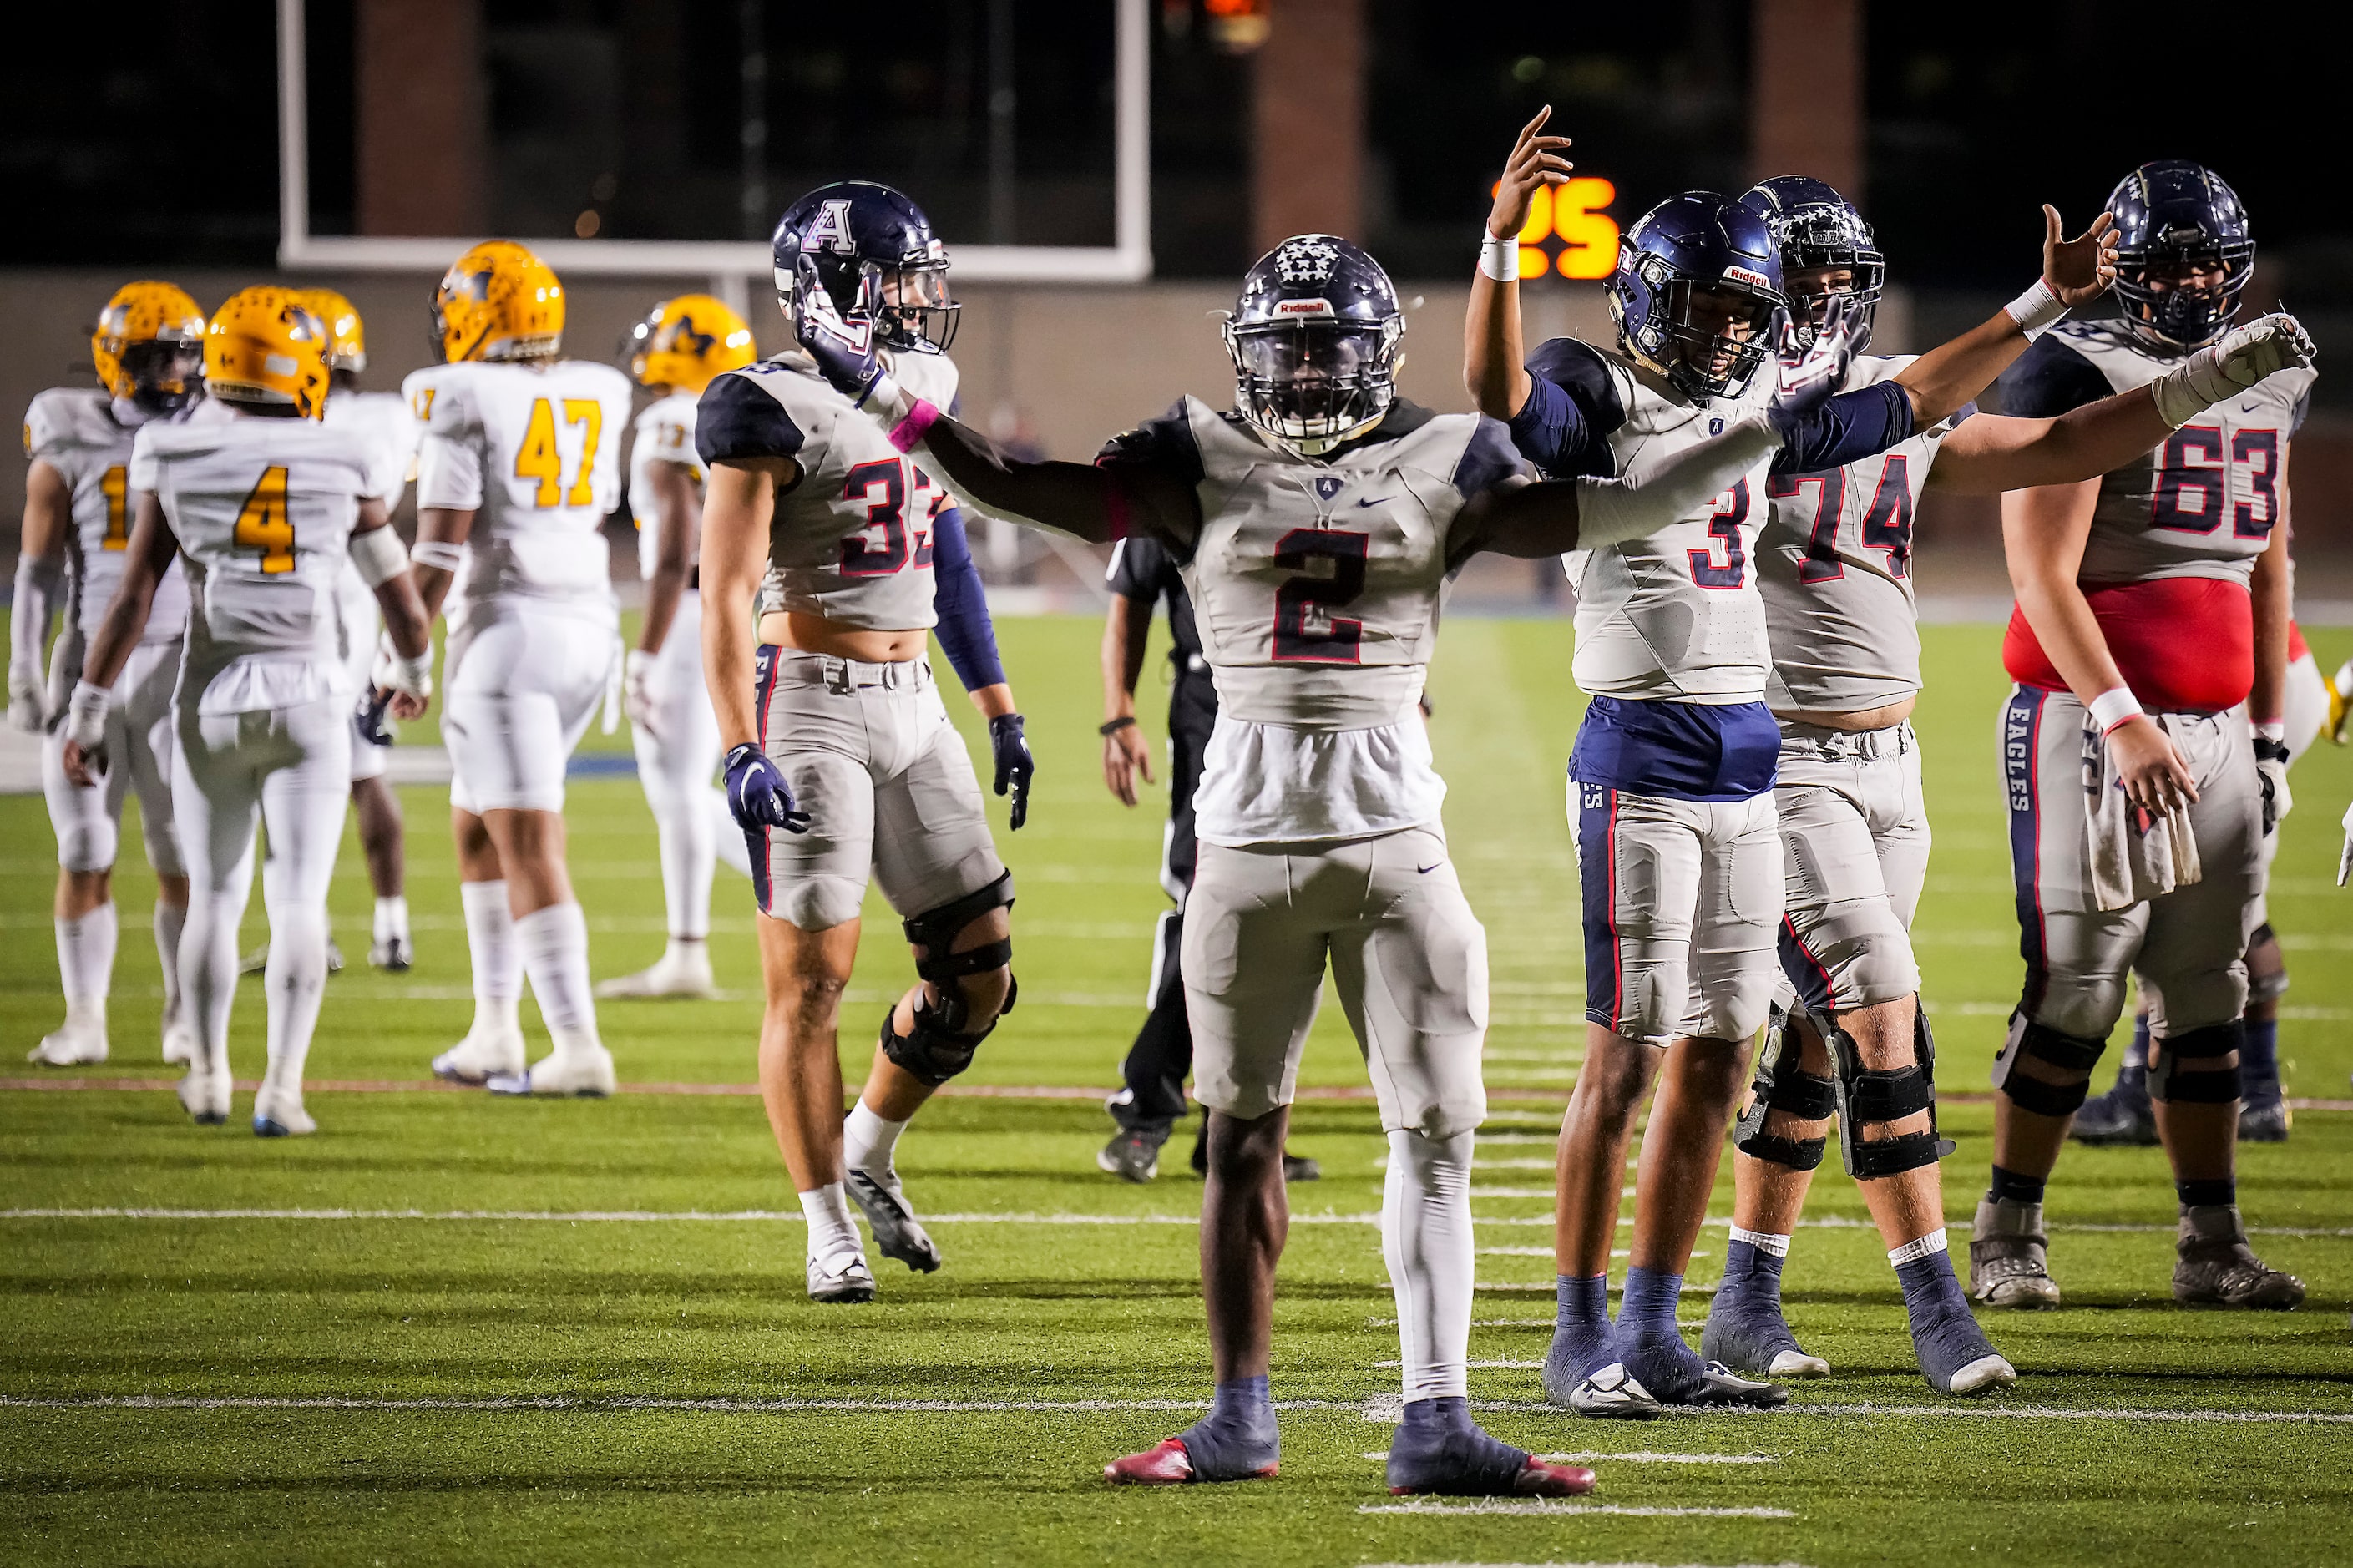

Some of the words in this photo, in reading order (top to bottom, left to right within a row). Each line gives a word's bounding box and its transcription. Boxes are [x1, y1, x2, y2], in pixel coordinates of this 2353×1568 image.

[800, 198, 857, 255] A
[1730, 268, 1768, 288] Riddell
[1280, 303, 1324, 313] Riddell
[514, 397, 603, 508] 47
[2150, 425, 2279, 541] 63
[232, 464, 296, 575] 4
[840, 457, 936, 576] 33
[1687, 473, 1751, 589] 3
[1769, 454, 1913, 584] 74
[1272, 527, 1370, 665] 2
[2006, 707, 2031, 812] EAGLES
